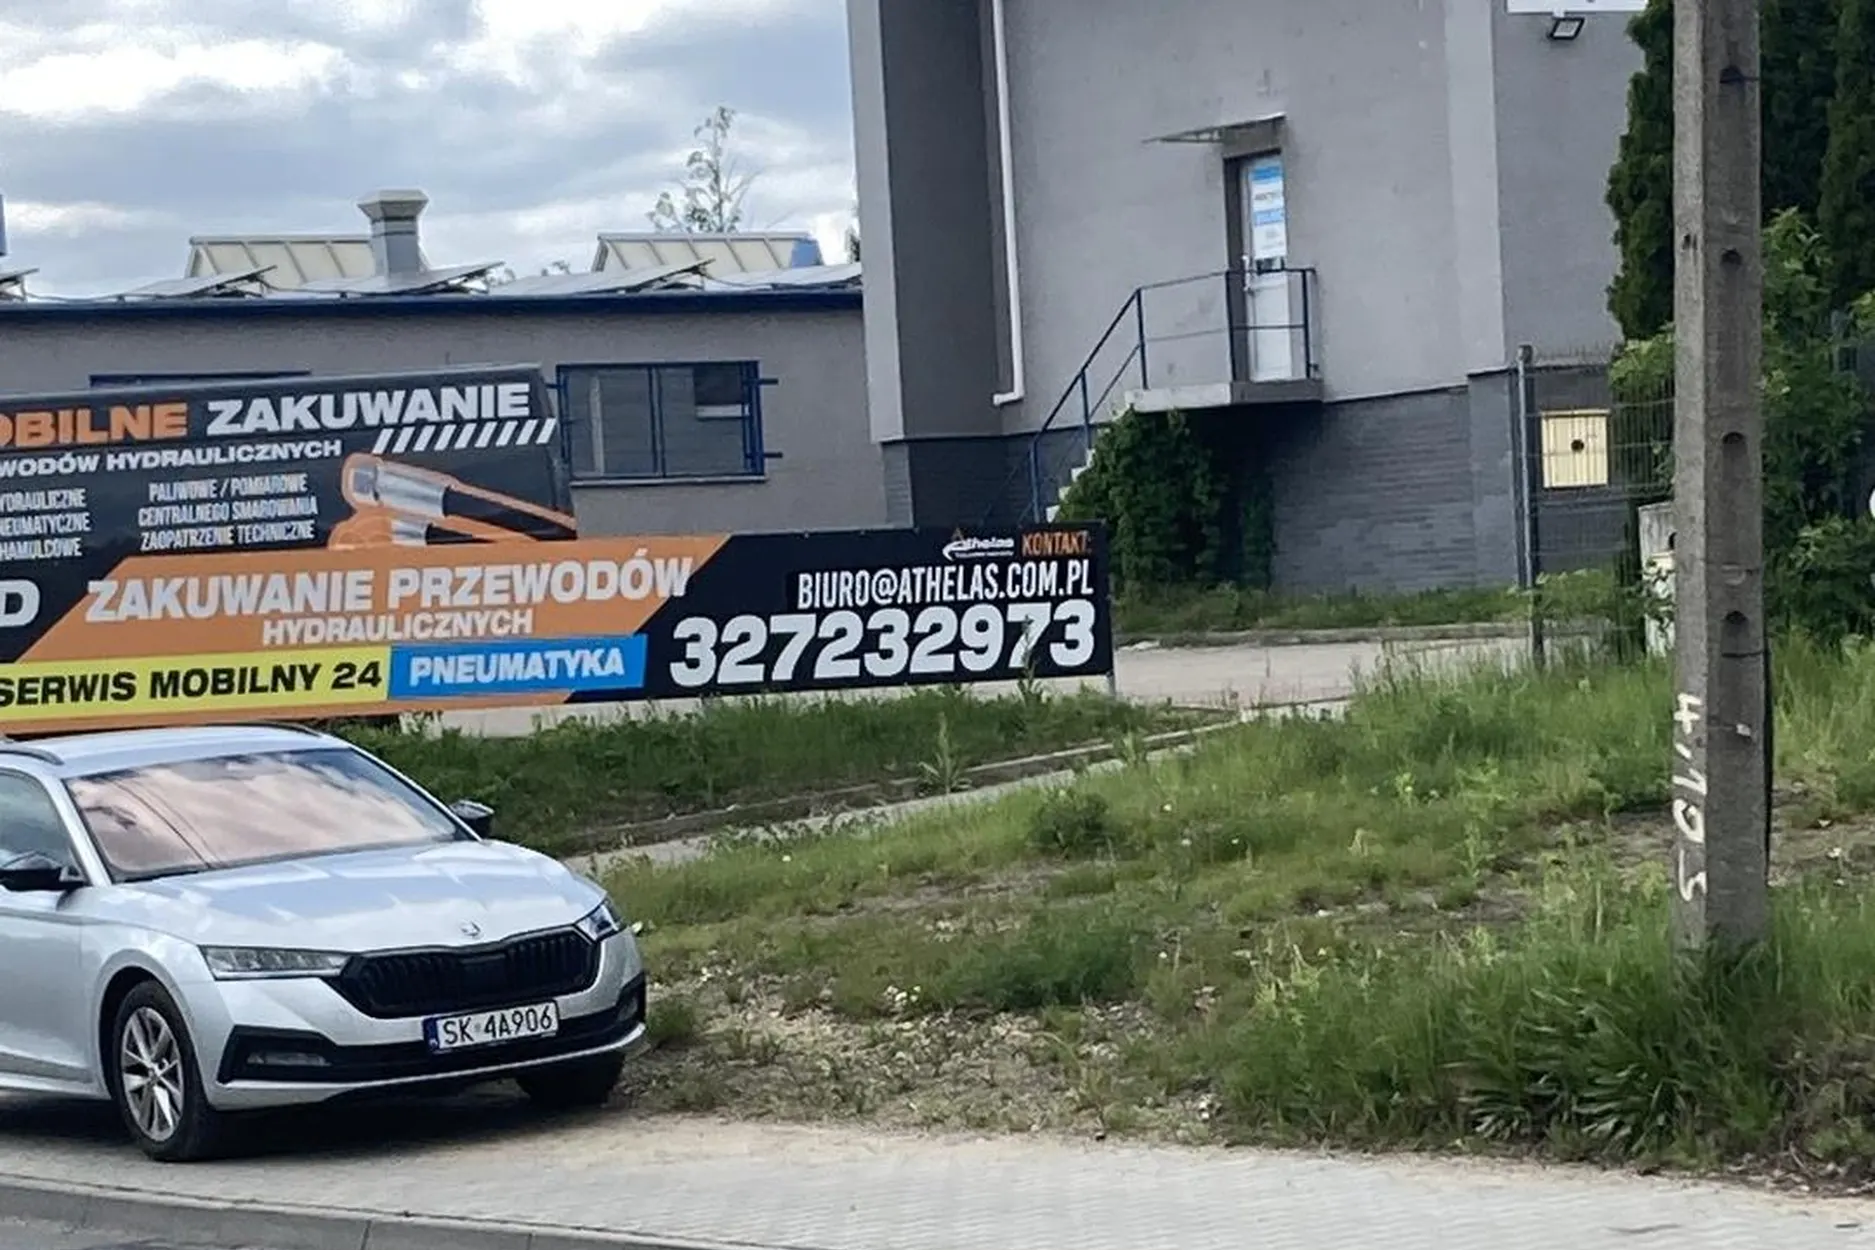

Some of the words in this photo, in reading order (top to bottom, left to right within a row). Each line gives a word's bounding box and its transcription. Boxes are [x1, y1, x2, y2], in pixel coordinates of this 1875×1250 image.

[206, 384, 531, 437] ZAKUWANIE
[106, 440, 342, 471] HYDRAULICZNYCH
[149, 479, 218, 502] PALIWOWE
[138, 502, 230, 527] CENTRALNEGO
[140, 525, 235, 552] ZAOPATRZENIE
[237, 520, 316, 544] TECHNICZNE
[85, 569, 376, 623] ZAKUWANIE
[387, 548, 694, 609] PRZEWODÓW
[797, 559, 1094, 610] BIURO@ATHELAS.COM.PL
[262, 609, 534, 646] HYDRAULICZNYCH
[669, 599, 1096, 688] 327232973
[150, 663, 322, 700] MOBILNY
[331, 661, 383, 690] 24
[409, 648, 626, 687] PNEUMATYKA
[442, 1017, 474, 1045] SK
[484, 1005, 552, 1038] 4A906
